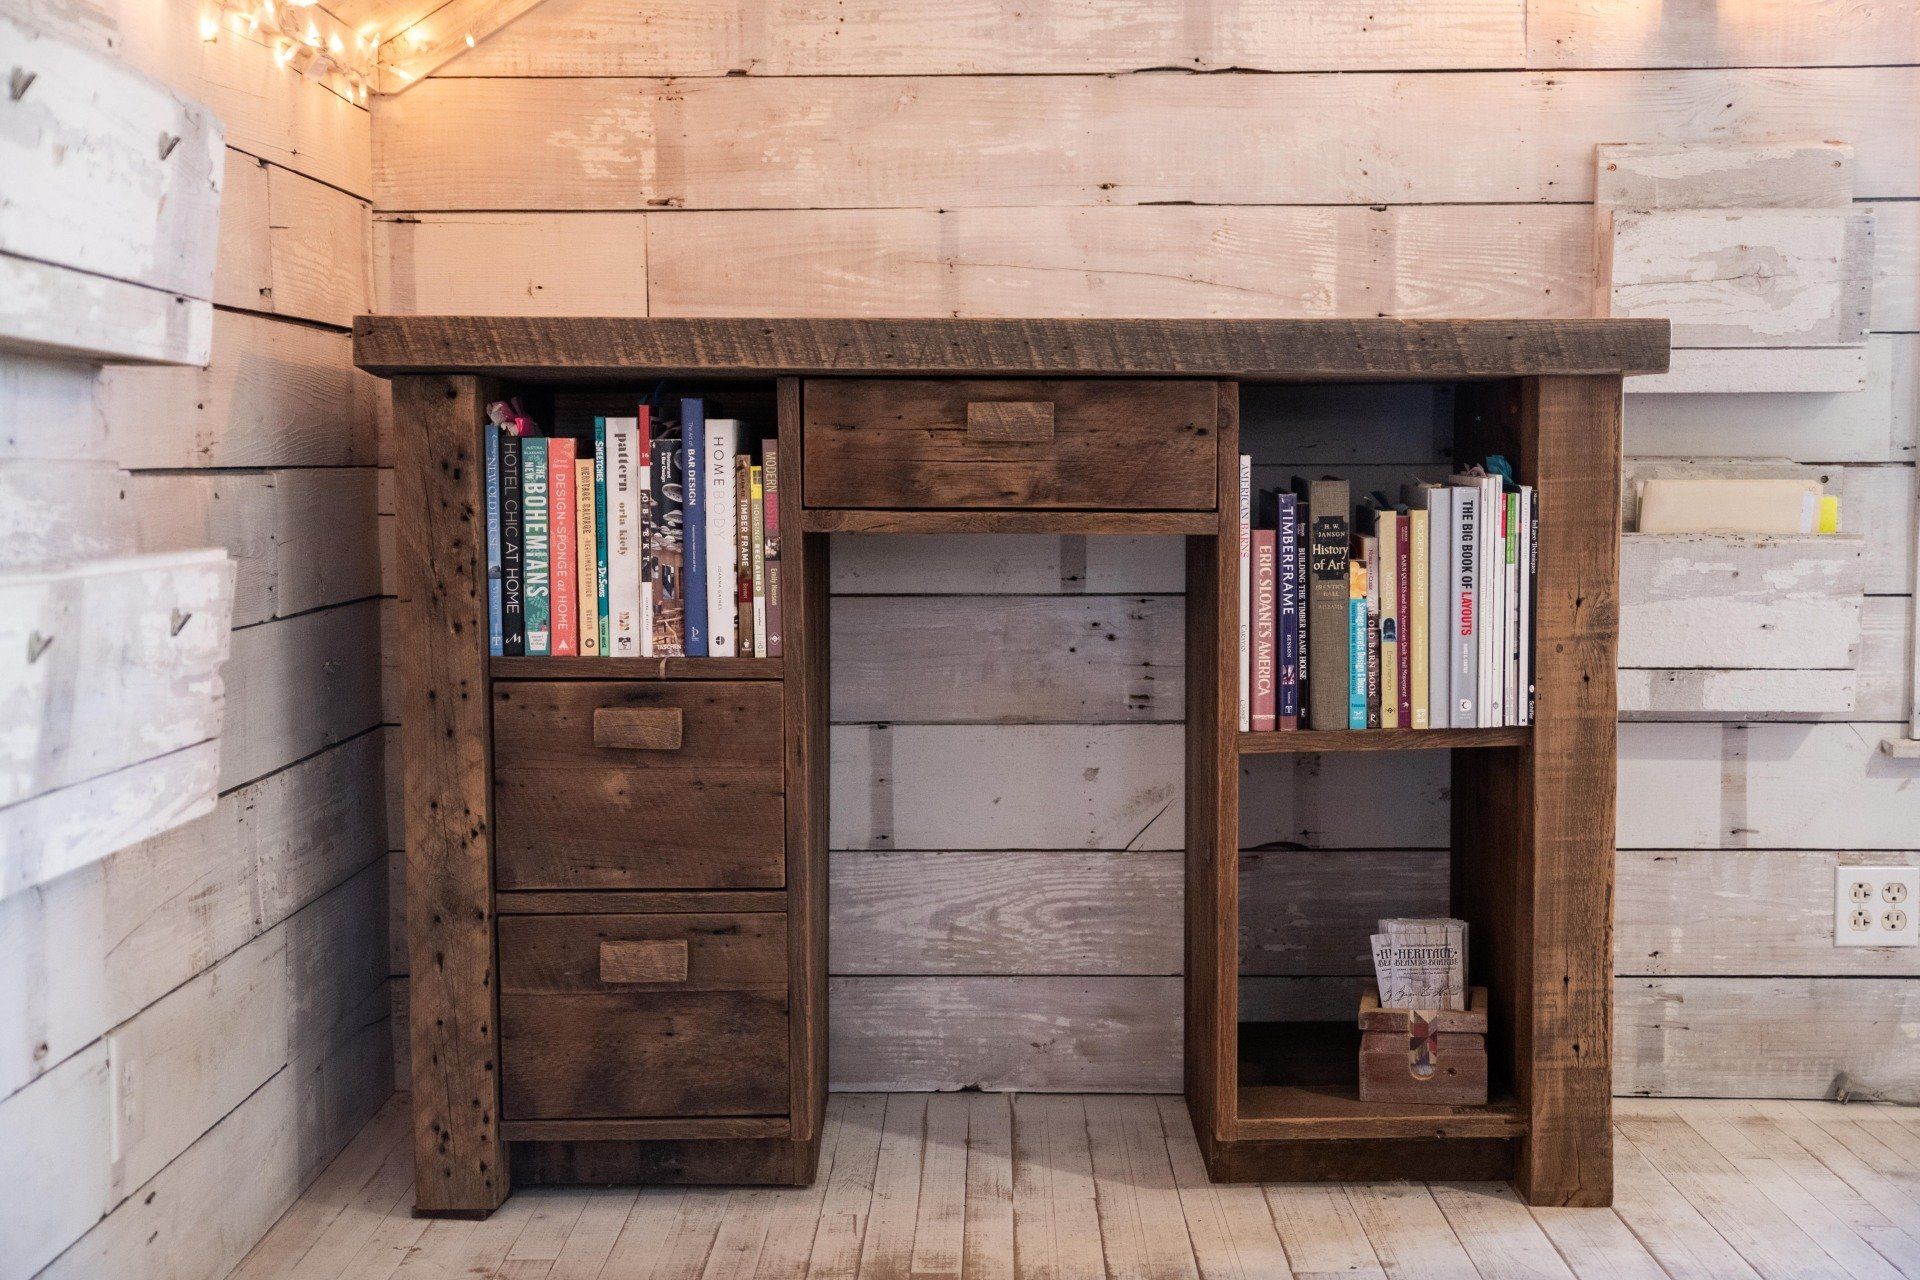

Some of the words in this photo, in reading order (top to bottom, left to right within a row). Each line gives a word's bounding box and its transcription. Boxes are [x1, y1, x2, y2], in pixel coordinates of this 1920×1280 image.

[488, 458, 496, 484] NEW
[504, 443, 517, 495] HOTEL
[525, 462, 534, 480] NEW
[535, 464, 545, 479] THE
[595, 440, 604, 482] SNEETCHES
[614, 433, 628, 492] pattern
[766, 452, 777, 492] MODERN
[488, 486, 497, 510] OLD
[581, 467, 590, 501] HERITAGE
[688, 470, 696, 506] DESIGN
[1240, 464, 1248, 519] AMERICAN
[505, 500, 518, 537] CHIC
[582, 504, 591, 534] SALVAGE
[619, 502, 627, 525] orla
[740, 499, 748, 532] TIMBER
[767, 493, 778, 529] RUSTIC
[1462, 500, 1473, 520] THE
[488, 512, 498, 550] HOUSE
[524, 483, 548, 597] BOHEMIANS
[618, 530, 627, 556] kiely
[1240, 523, 1249, 558] BARNS
[1462, 523, 1472, 541] BIG
[506, 542, 518, 562] AT
[1259, 545, 1272, 576] ERIC
[1282, 506, 1294, 615] TIMBERFRAME
[1312, 544, 1349, 559] History
[1314, 559, 1326, 570] of
[1328, 560, 1346, 570] Art
[1462, 544, 1472, 573] BOOK
[506, 568, 519, 614] HOME
[558, 580, 566, 592] at
[598, 580, 607, 597] Seuss
[1298, 585, 1306, 599] THE
[1462, 576, 1472, 589] OF
[558, 596, 567, 630] HOME
[1259, 579, 1272, 638] SLOANE'S
[1298, 602, 1306, 628] TIMBER
[1356, 603, 1366, 626] Salvage
[1461, 592, 1472, 636] LAYOUTS
[1357, 627, 1366, 651] Secrets
[1258, 640, 1271, 696] AMERICA
[1356, 652, 1366, 672] Design
[1357, 678, 1366, 695] Decor
[1398, 948, 1454, 959] HERITAGE
